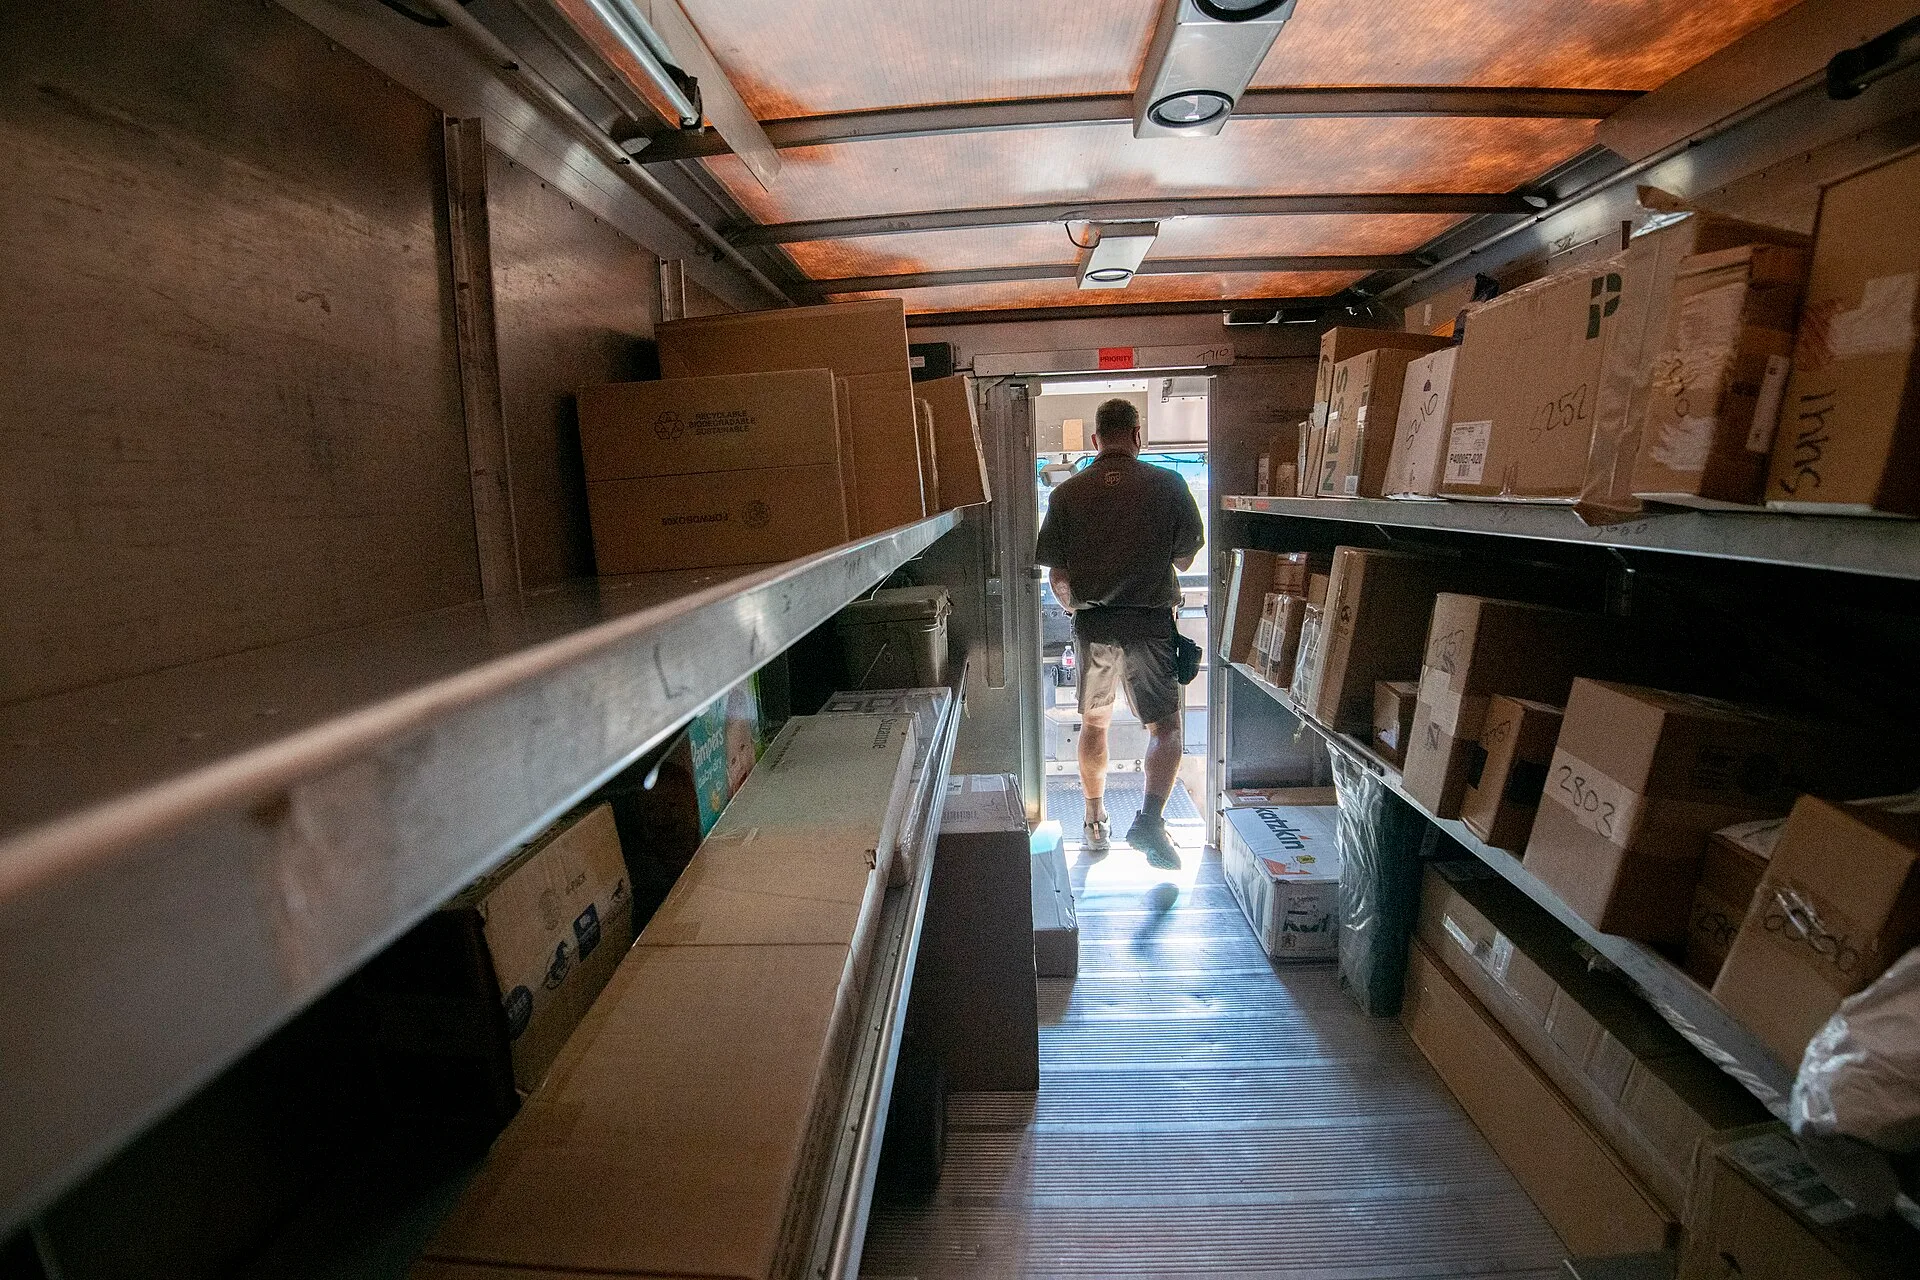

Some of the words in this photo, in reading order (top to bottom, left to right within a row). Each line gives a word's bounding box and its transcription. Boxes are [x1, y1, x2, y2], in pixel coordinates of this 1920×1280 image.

[1099, 355, 1133, 363] PRIORITY
[695, 410, 747, 420] RECYCLABLE
[687, 417, 757, 428] BIODEGRADABLE
[695, 425, 749, 435] SUSTAINABLE
[1559, 765, 1615, 839] 2803
